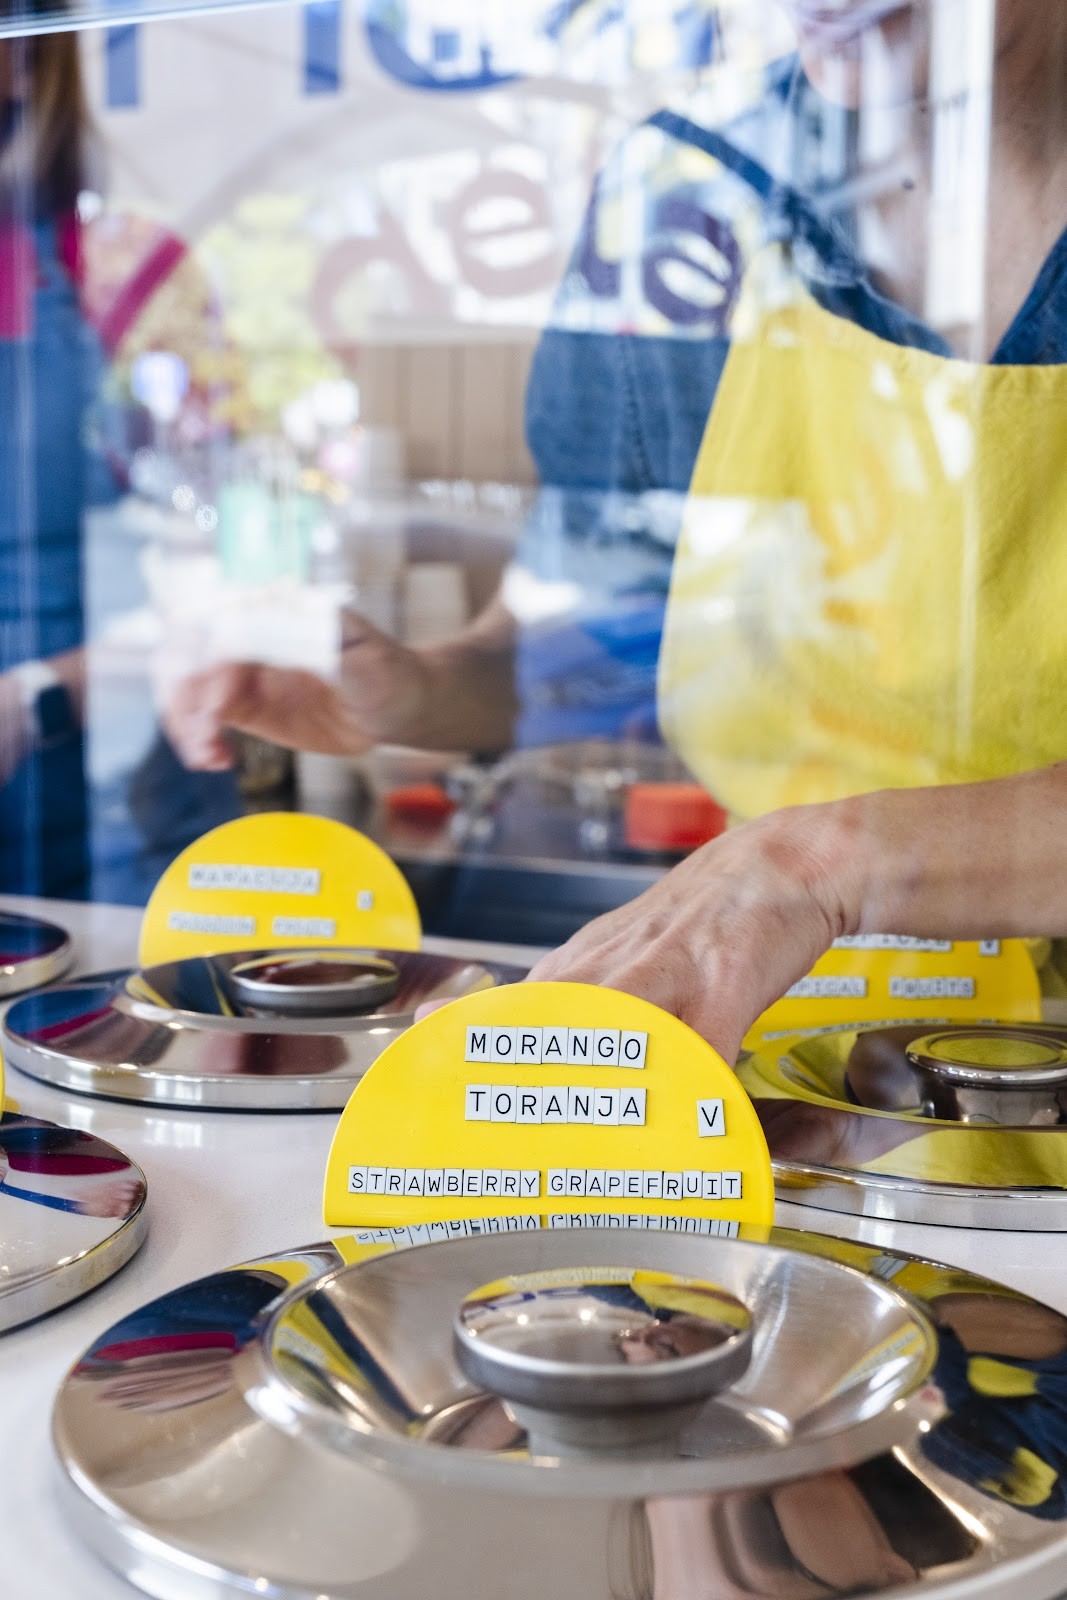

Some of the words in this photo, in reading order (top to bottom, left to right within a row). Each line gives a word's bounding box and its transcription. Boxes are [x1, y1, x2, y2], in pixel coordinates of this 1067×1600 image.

[470, 1032, 642, 1060] MORANGO
[469, 1090, 641, 1118] TORANJA
[701, 1104, 719, 1129] V
[351, 1171, 536, 1194] STRAWBERRY
[550, 1174, 738, 1196] GRAPEFRUIT
